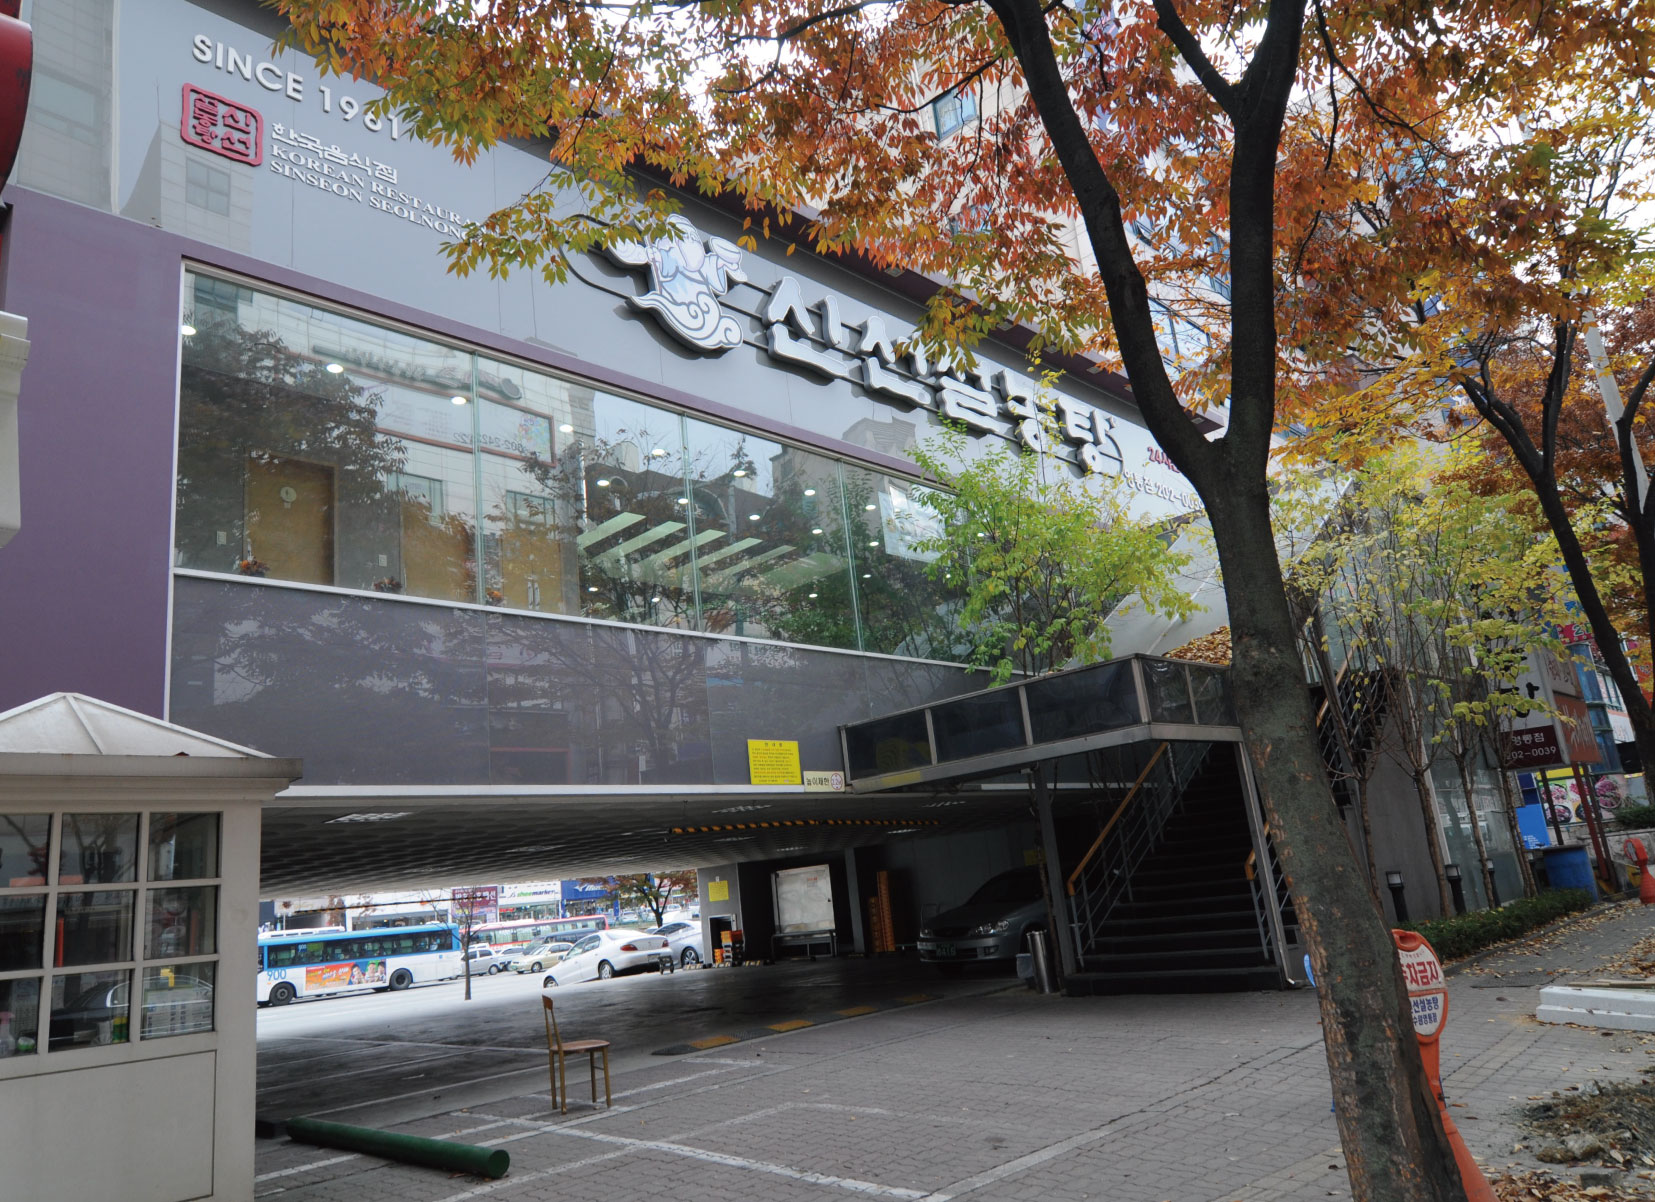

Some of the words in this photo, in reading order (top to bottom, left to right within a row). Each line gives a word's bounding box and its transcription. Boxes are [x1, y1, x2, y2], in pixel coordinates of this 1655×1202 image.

[192, 33, 304, 102] SINCE
[318, 85, 399, 140] 1961
[271, 144, 365, 189] KOREAN
[272, 122, 398, 185] 한국음식점
[270, 160, 362, 204] SINSEON
[762, 275, 1117, 475] 신선설농탕
[1511, 732, 1545, 746] 영통점
[266, 968, 287, 981] 900
[1411, 996, 1439, 1014] 선설농탕
